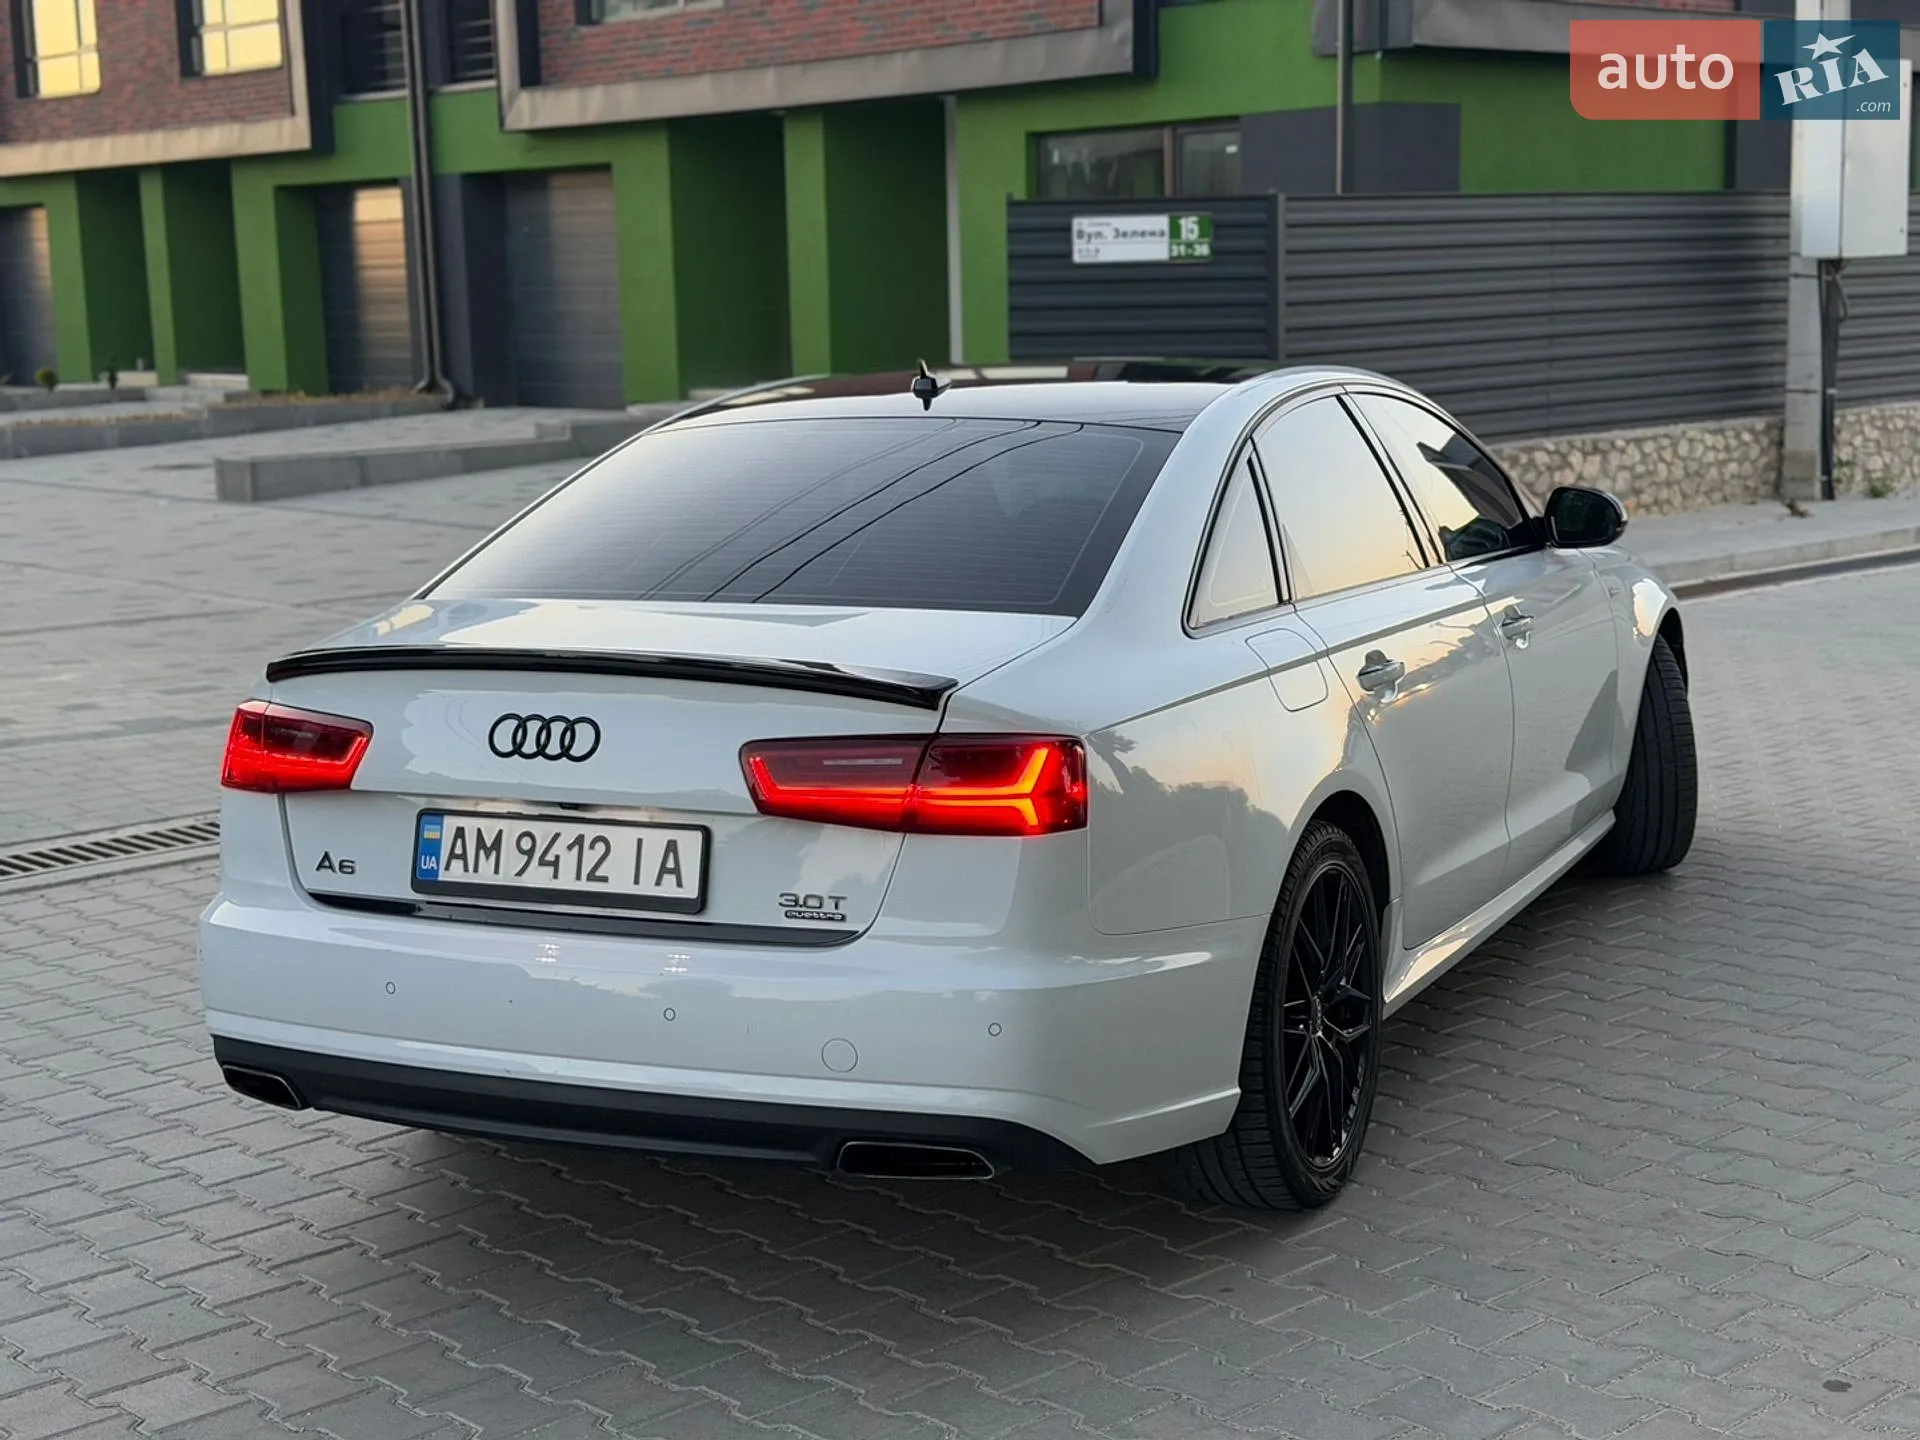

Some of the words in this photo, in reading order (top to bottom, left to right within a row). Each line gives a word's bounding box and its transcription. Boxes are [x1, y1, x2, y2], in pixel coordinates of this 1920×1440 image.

[1113, 226, 1166, 239] Зелена
[1178, 216, 1200, 241] 15
[315, 850, 356, 875] A6
[420, 855, 438, 870] UA
[444, 826, 503, 875] AM
[514, 830, 612, 883] 9412
[633, 837, 684, 888] IA
